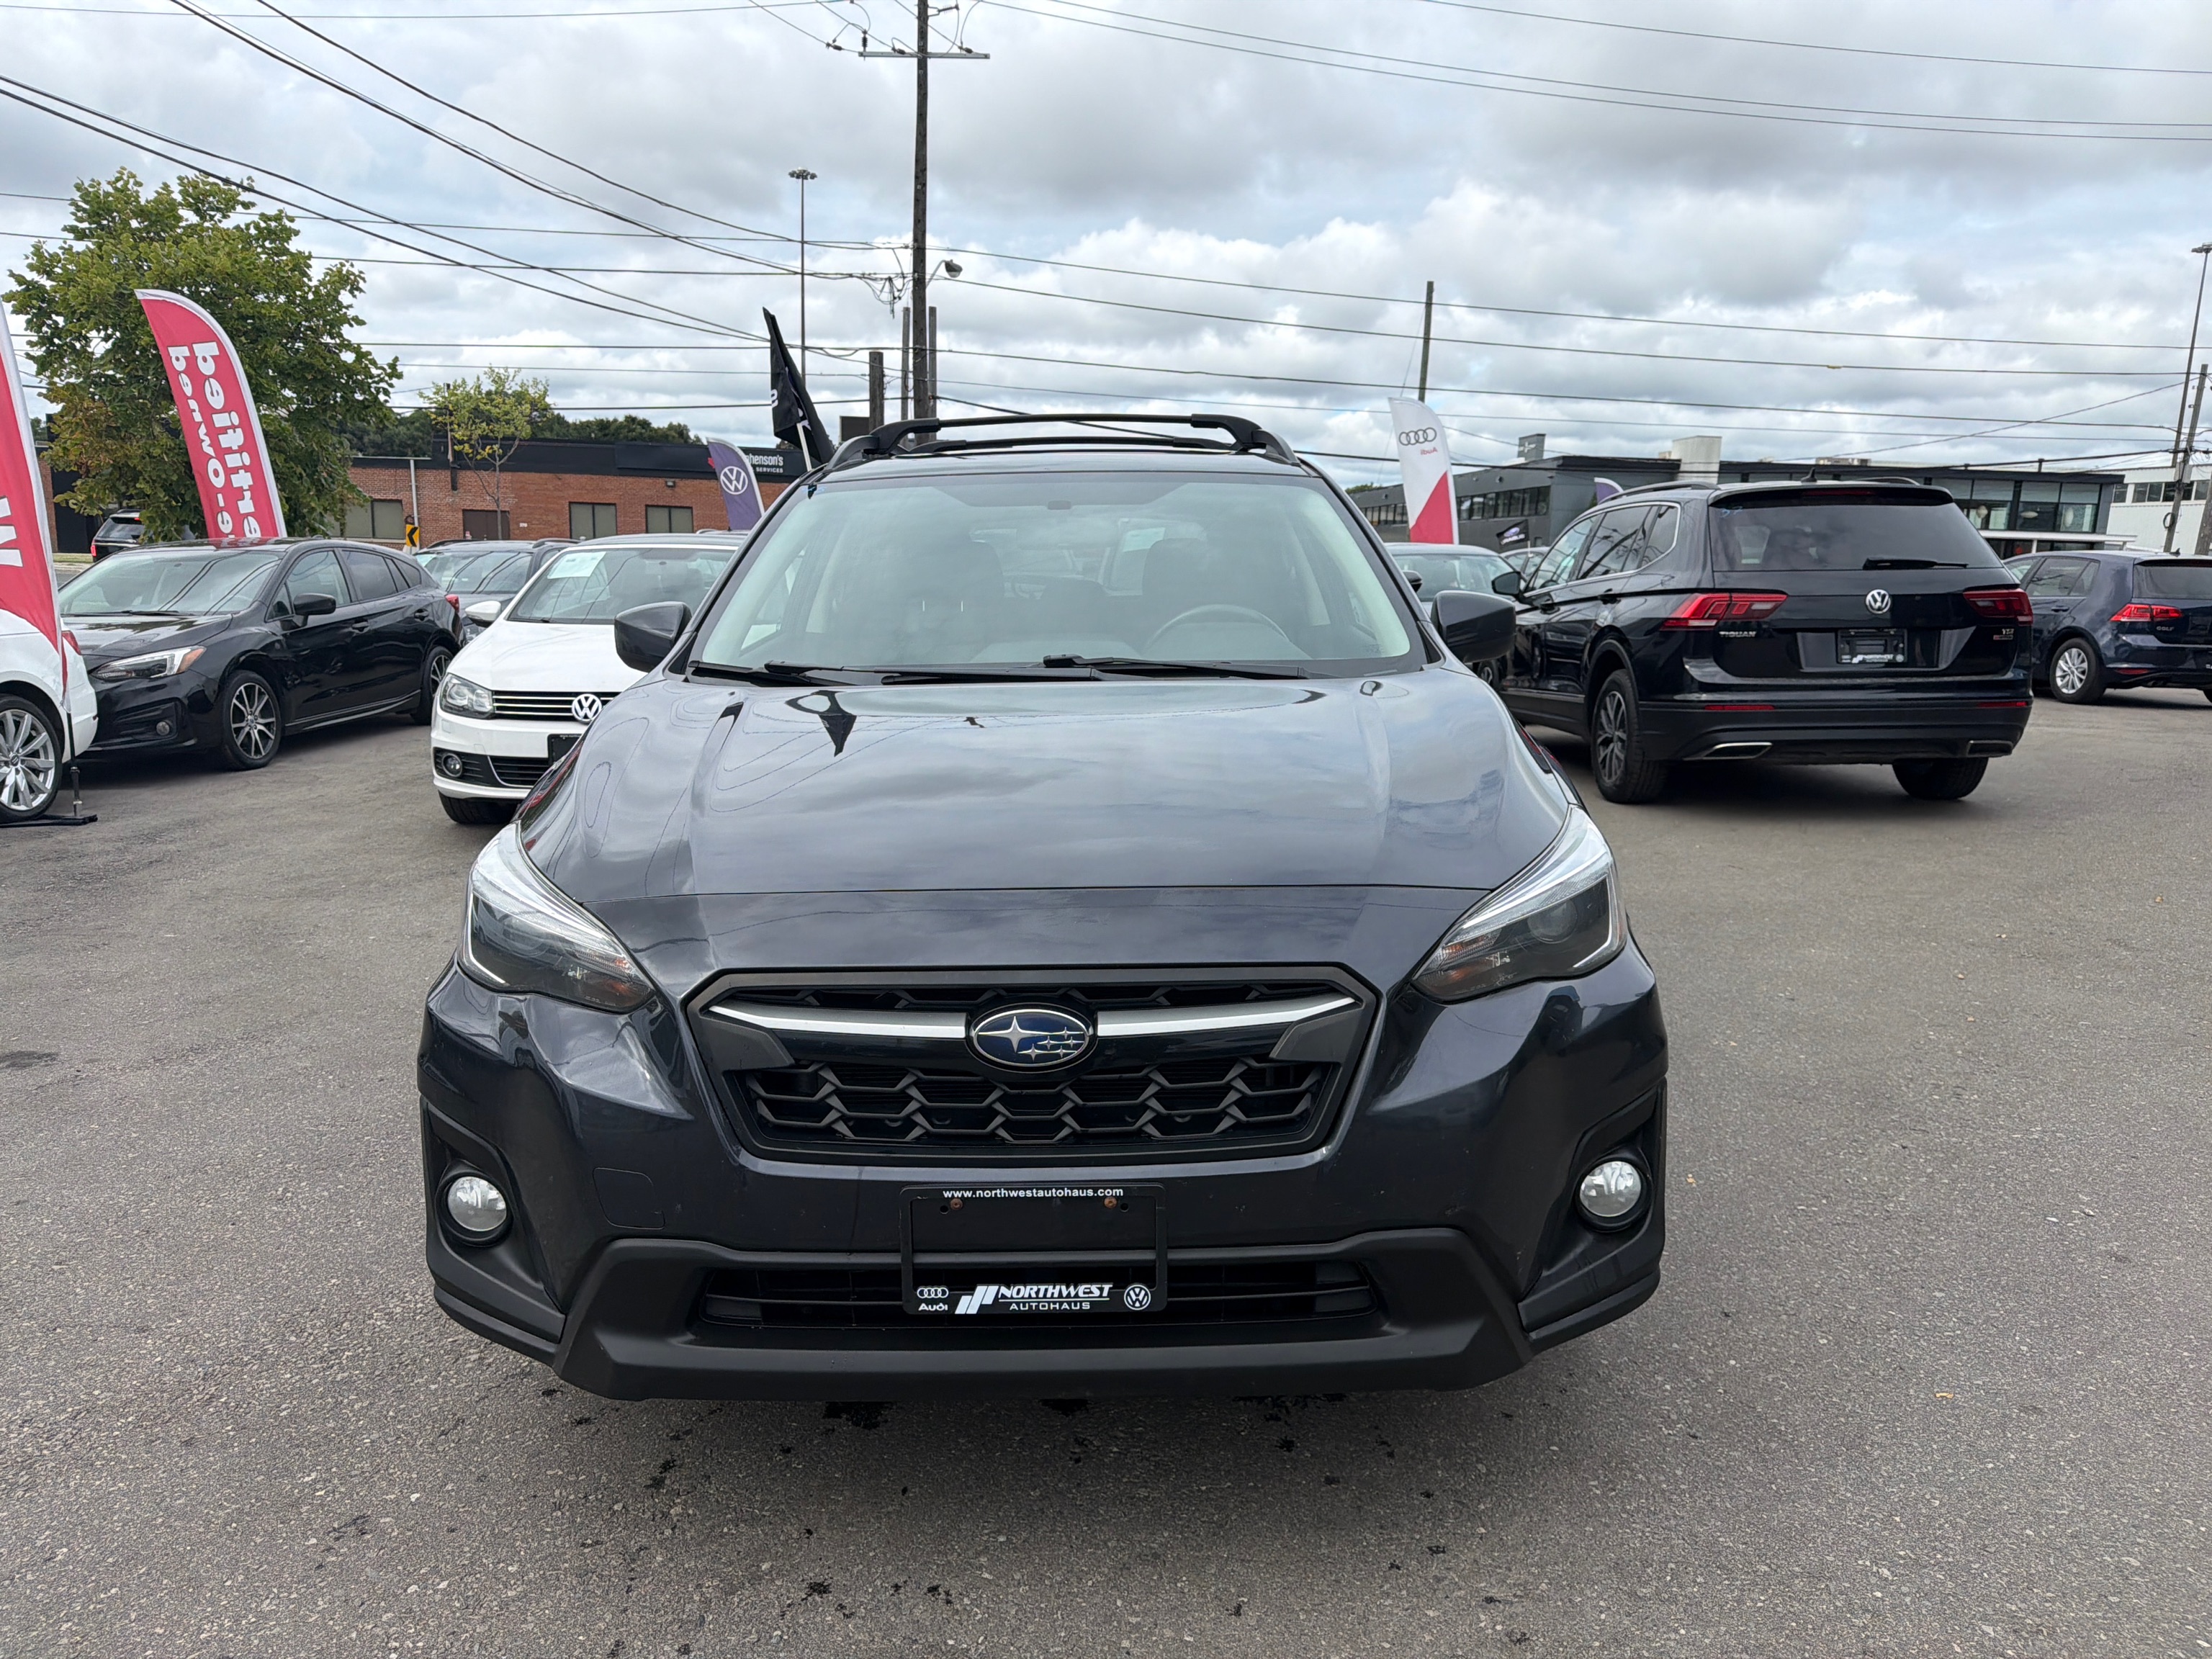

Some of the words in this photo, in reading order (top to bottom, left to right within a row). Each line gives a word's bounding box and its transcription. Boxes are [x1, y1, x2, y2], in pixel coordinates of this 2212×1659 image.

[943, 1187, 1124, 1198] www.northwestautohaus.com
[999, 1284, 1113, 1298] NORTHWEST
[917, 1303, 948, 1311] Audi
[1009, 1302, 1091, 1310] AUTOHAUS
